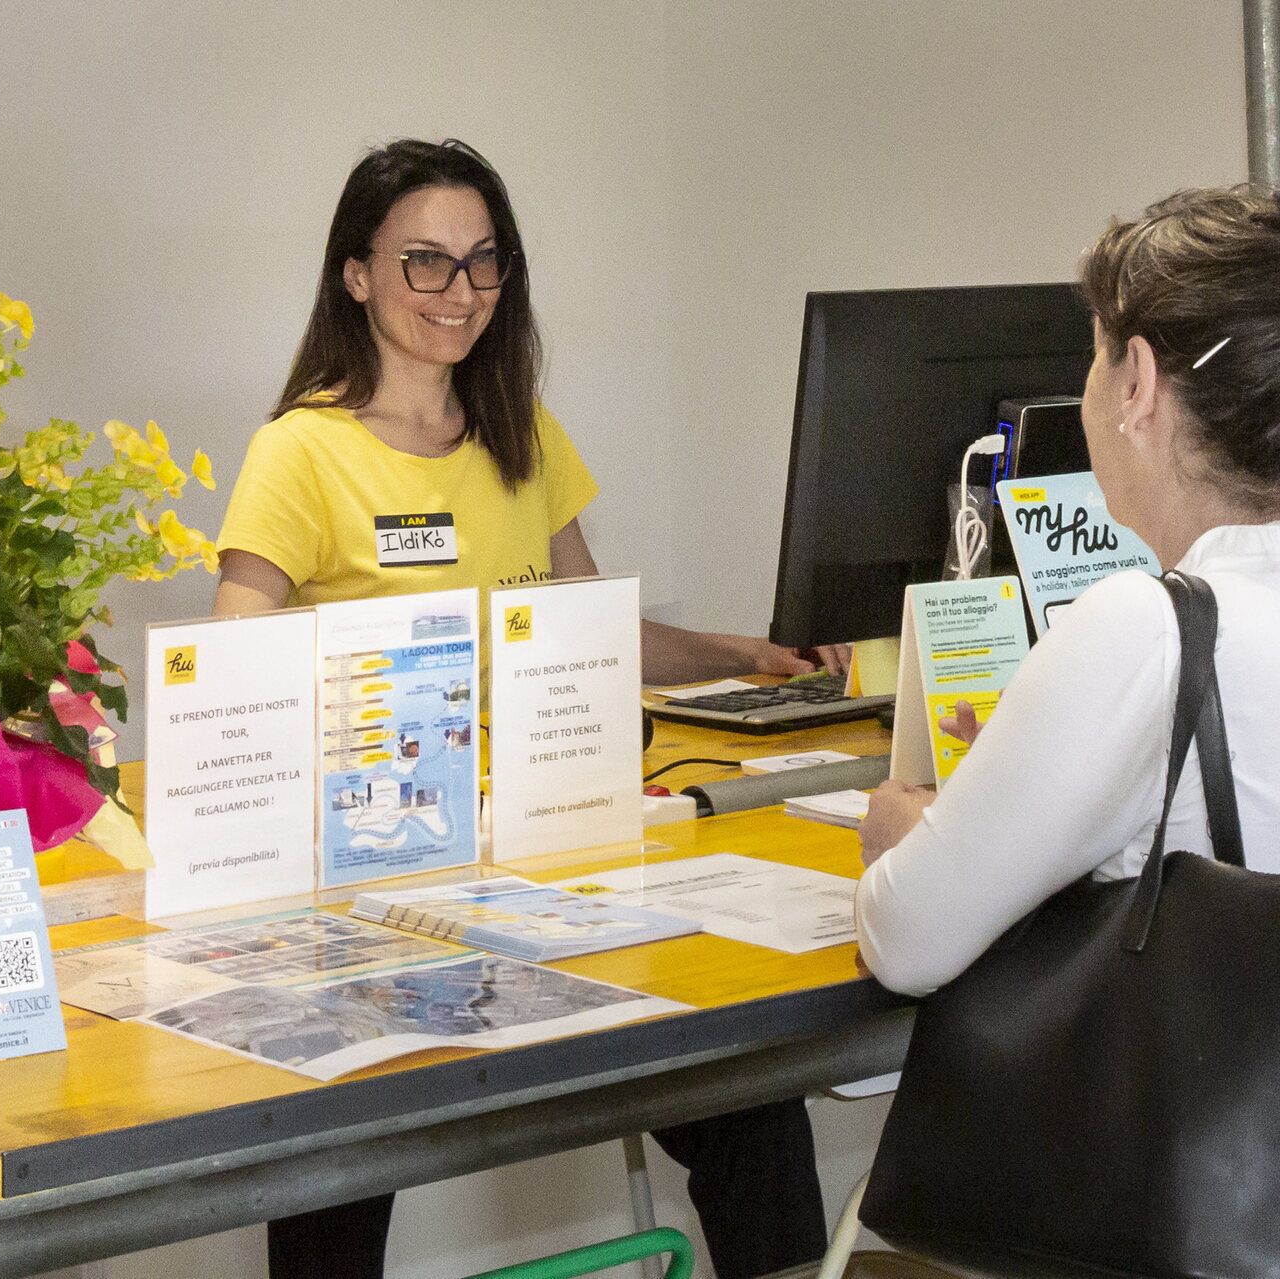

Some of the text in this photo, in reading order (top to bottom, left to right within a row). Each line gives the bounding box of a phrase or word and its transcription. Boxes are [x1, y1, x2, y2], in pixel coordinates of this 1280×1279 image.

[401, 517, 426, 526] I AM
[1032, 555, 1148, 579] un soggiorno come vuoi tu
[925, 598, 938, 606] Hai
[952, 595, 987, 606] problema
[515, 657, 619, 678] IF YOU BOOK ONE OF OUR
[548, 684, 578, 695] TOURS,
[170, 699, 299, 724] SE PRENOTI UNO DEI NOSTRI
[537, 704, 590, 719] THE SHUTTLE
[221, 728, 249, 739] TOUR,
[530, 724, 602, 741] TO GET TO VENICE
[197, 752, 272, 770] LA NAVETTA PER
[530, 747, 596, 763] IS FREE FOR YOU
[168, 770, 300, 797] RAGGIUNGERE VENEZIA TE LA
[195, 797, 269, 816] REGALIAMO NOI
[525, 796, 613, 819] (subject to availability)
[189, 848, 279, 874] (previa disponibilità)
